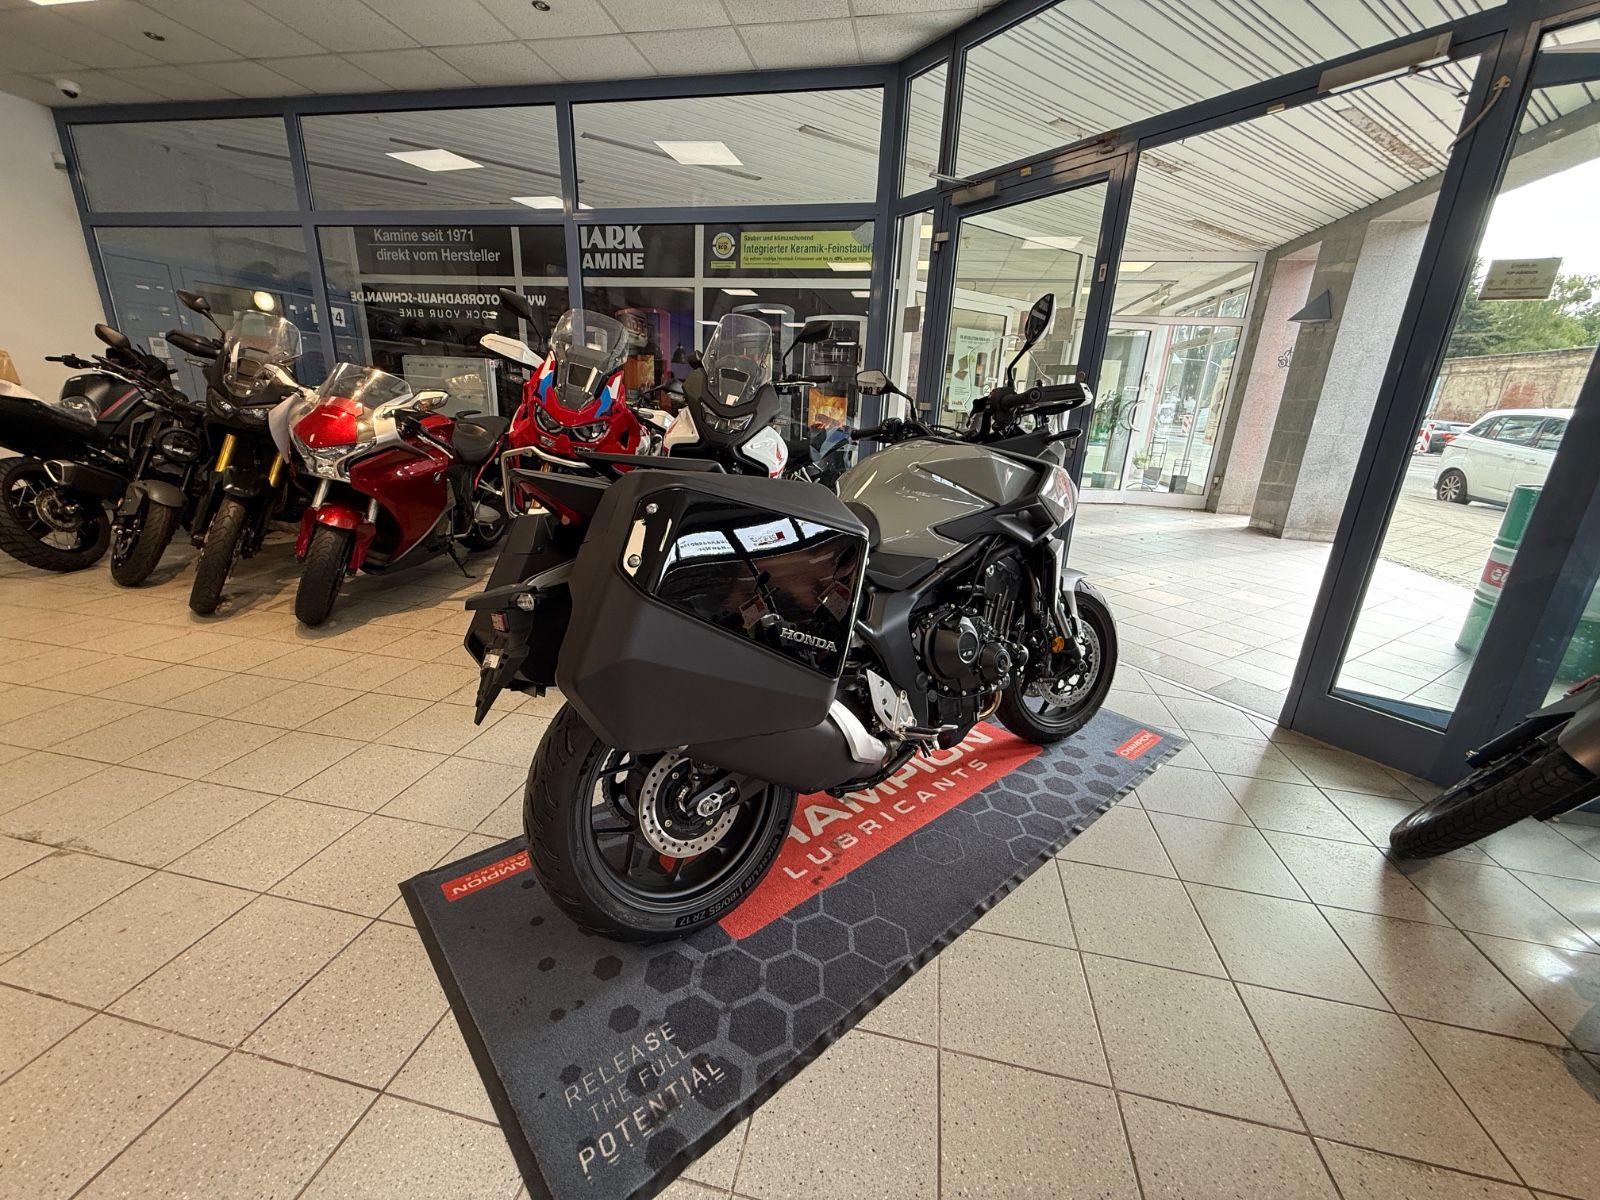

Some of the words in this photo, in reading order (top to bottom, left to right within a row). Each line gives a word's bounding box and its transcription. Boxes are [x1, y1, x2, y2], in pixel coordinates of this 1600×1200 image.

[373, 228, 418, 242] Kamine
[421, 228, 444, 242] seit
[446, 228, 474, 242] 1971
[743, 243, 788, 255] Integrierter
[376, 247, 411, 261] direkt
[412, 250, 438, 261] vom
[441, 248, 501, 262] Hersteller
[582, 252, 645, 269] AMINE
[779, 627, 838, 653] HONDA
[787, 727, 993, 844] AMPION
[782, 758, 988, 880] LUBRICANTS
[452, 857, 528, 895] AMPION
[564, 1021, 676, 1109] RELEASE
[587, 1083, 633, 1122] THE
[638, 1046, 691, 1088] FULL
[578, 1063, 725, 1180] POTENTIAL
